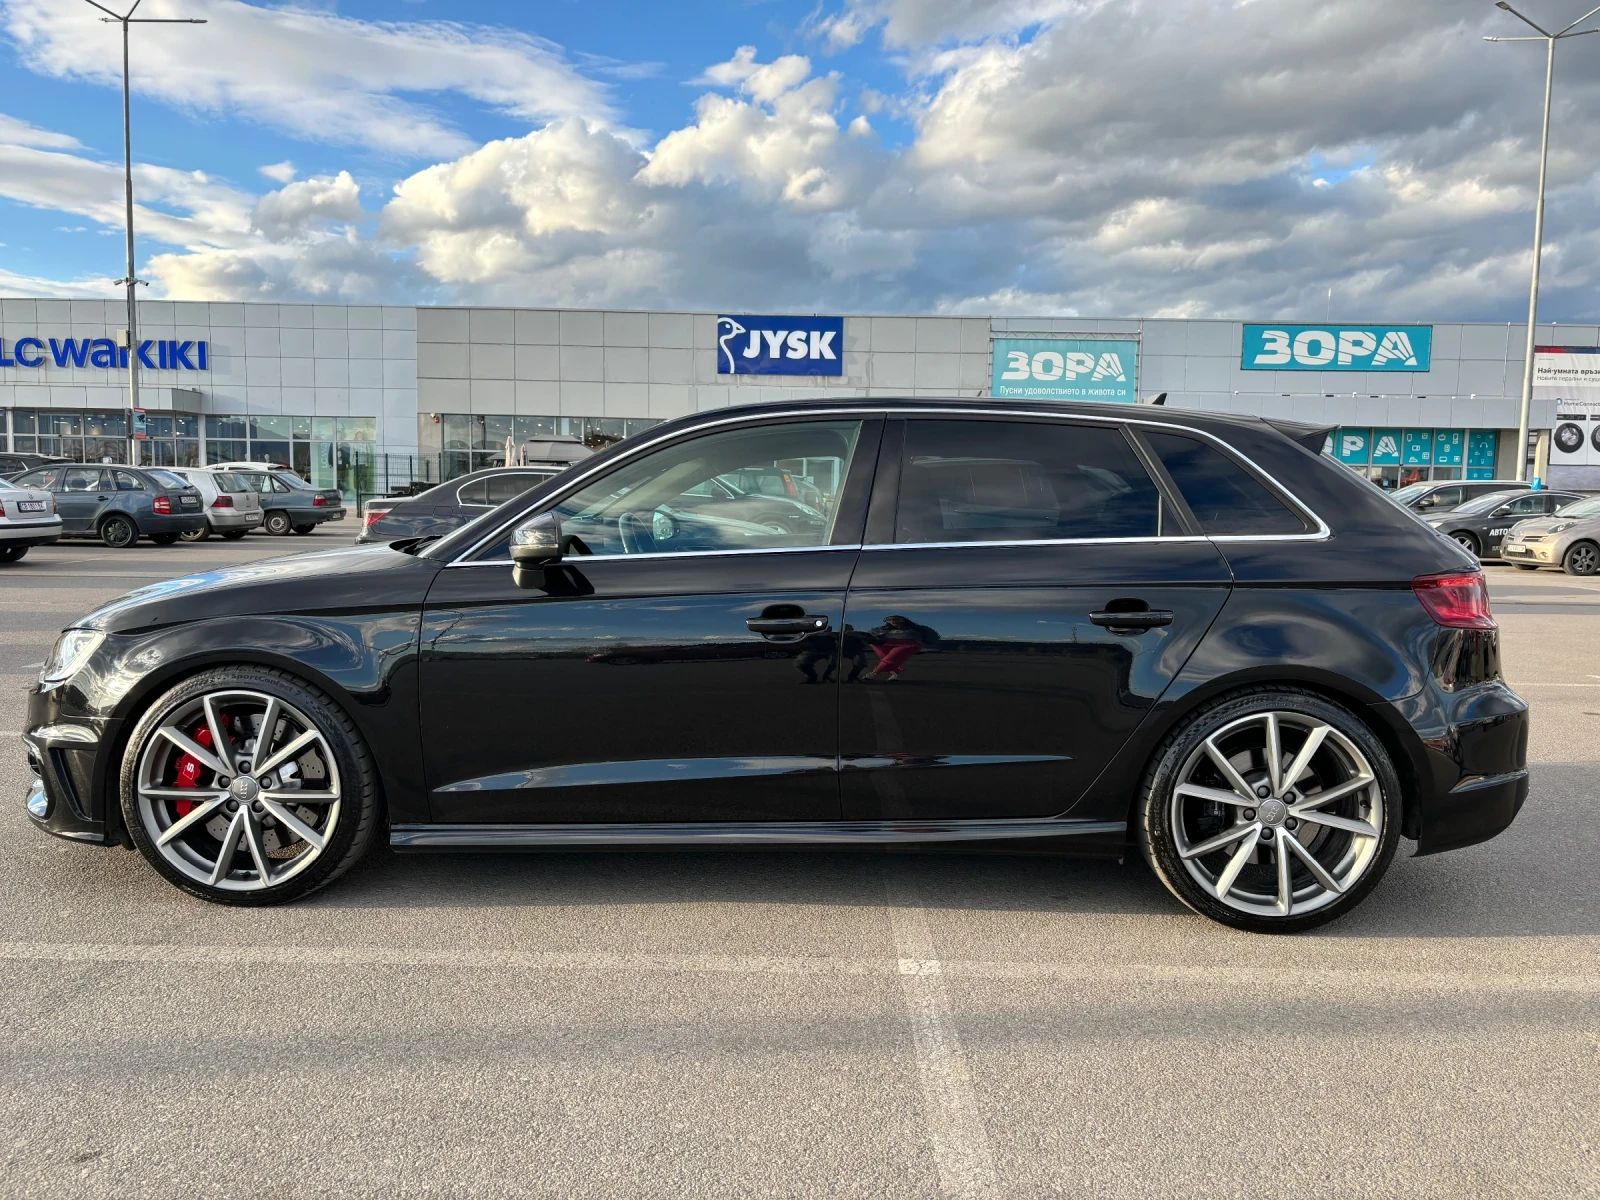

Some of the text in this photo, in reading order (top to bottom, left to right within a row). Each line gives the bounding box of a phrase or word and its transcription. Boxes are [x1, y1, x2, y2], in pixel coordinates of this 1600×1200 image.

[0, 337, 45, 367] LC
[743, 329, 837, 360] JYSK
[1253, 330, 1418, 366] ЗОРА
[1001, 351, 1126, 381] ЗОРА
[1000, 386, 1022, 396] Пусни
[1024, 386, 1080, 396] удоволствието
[1088, 388, 1115, 396] живота
[1117, 388, 1126, 396] си
[1489, 528, 1511, 537] АВТО
[231, 672, 294, 692] SportContact
